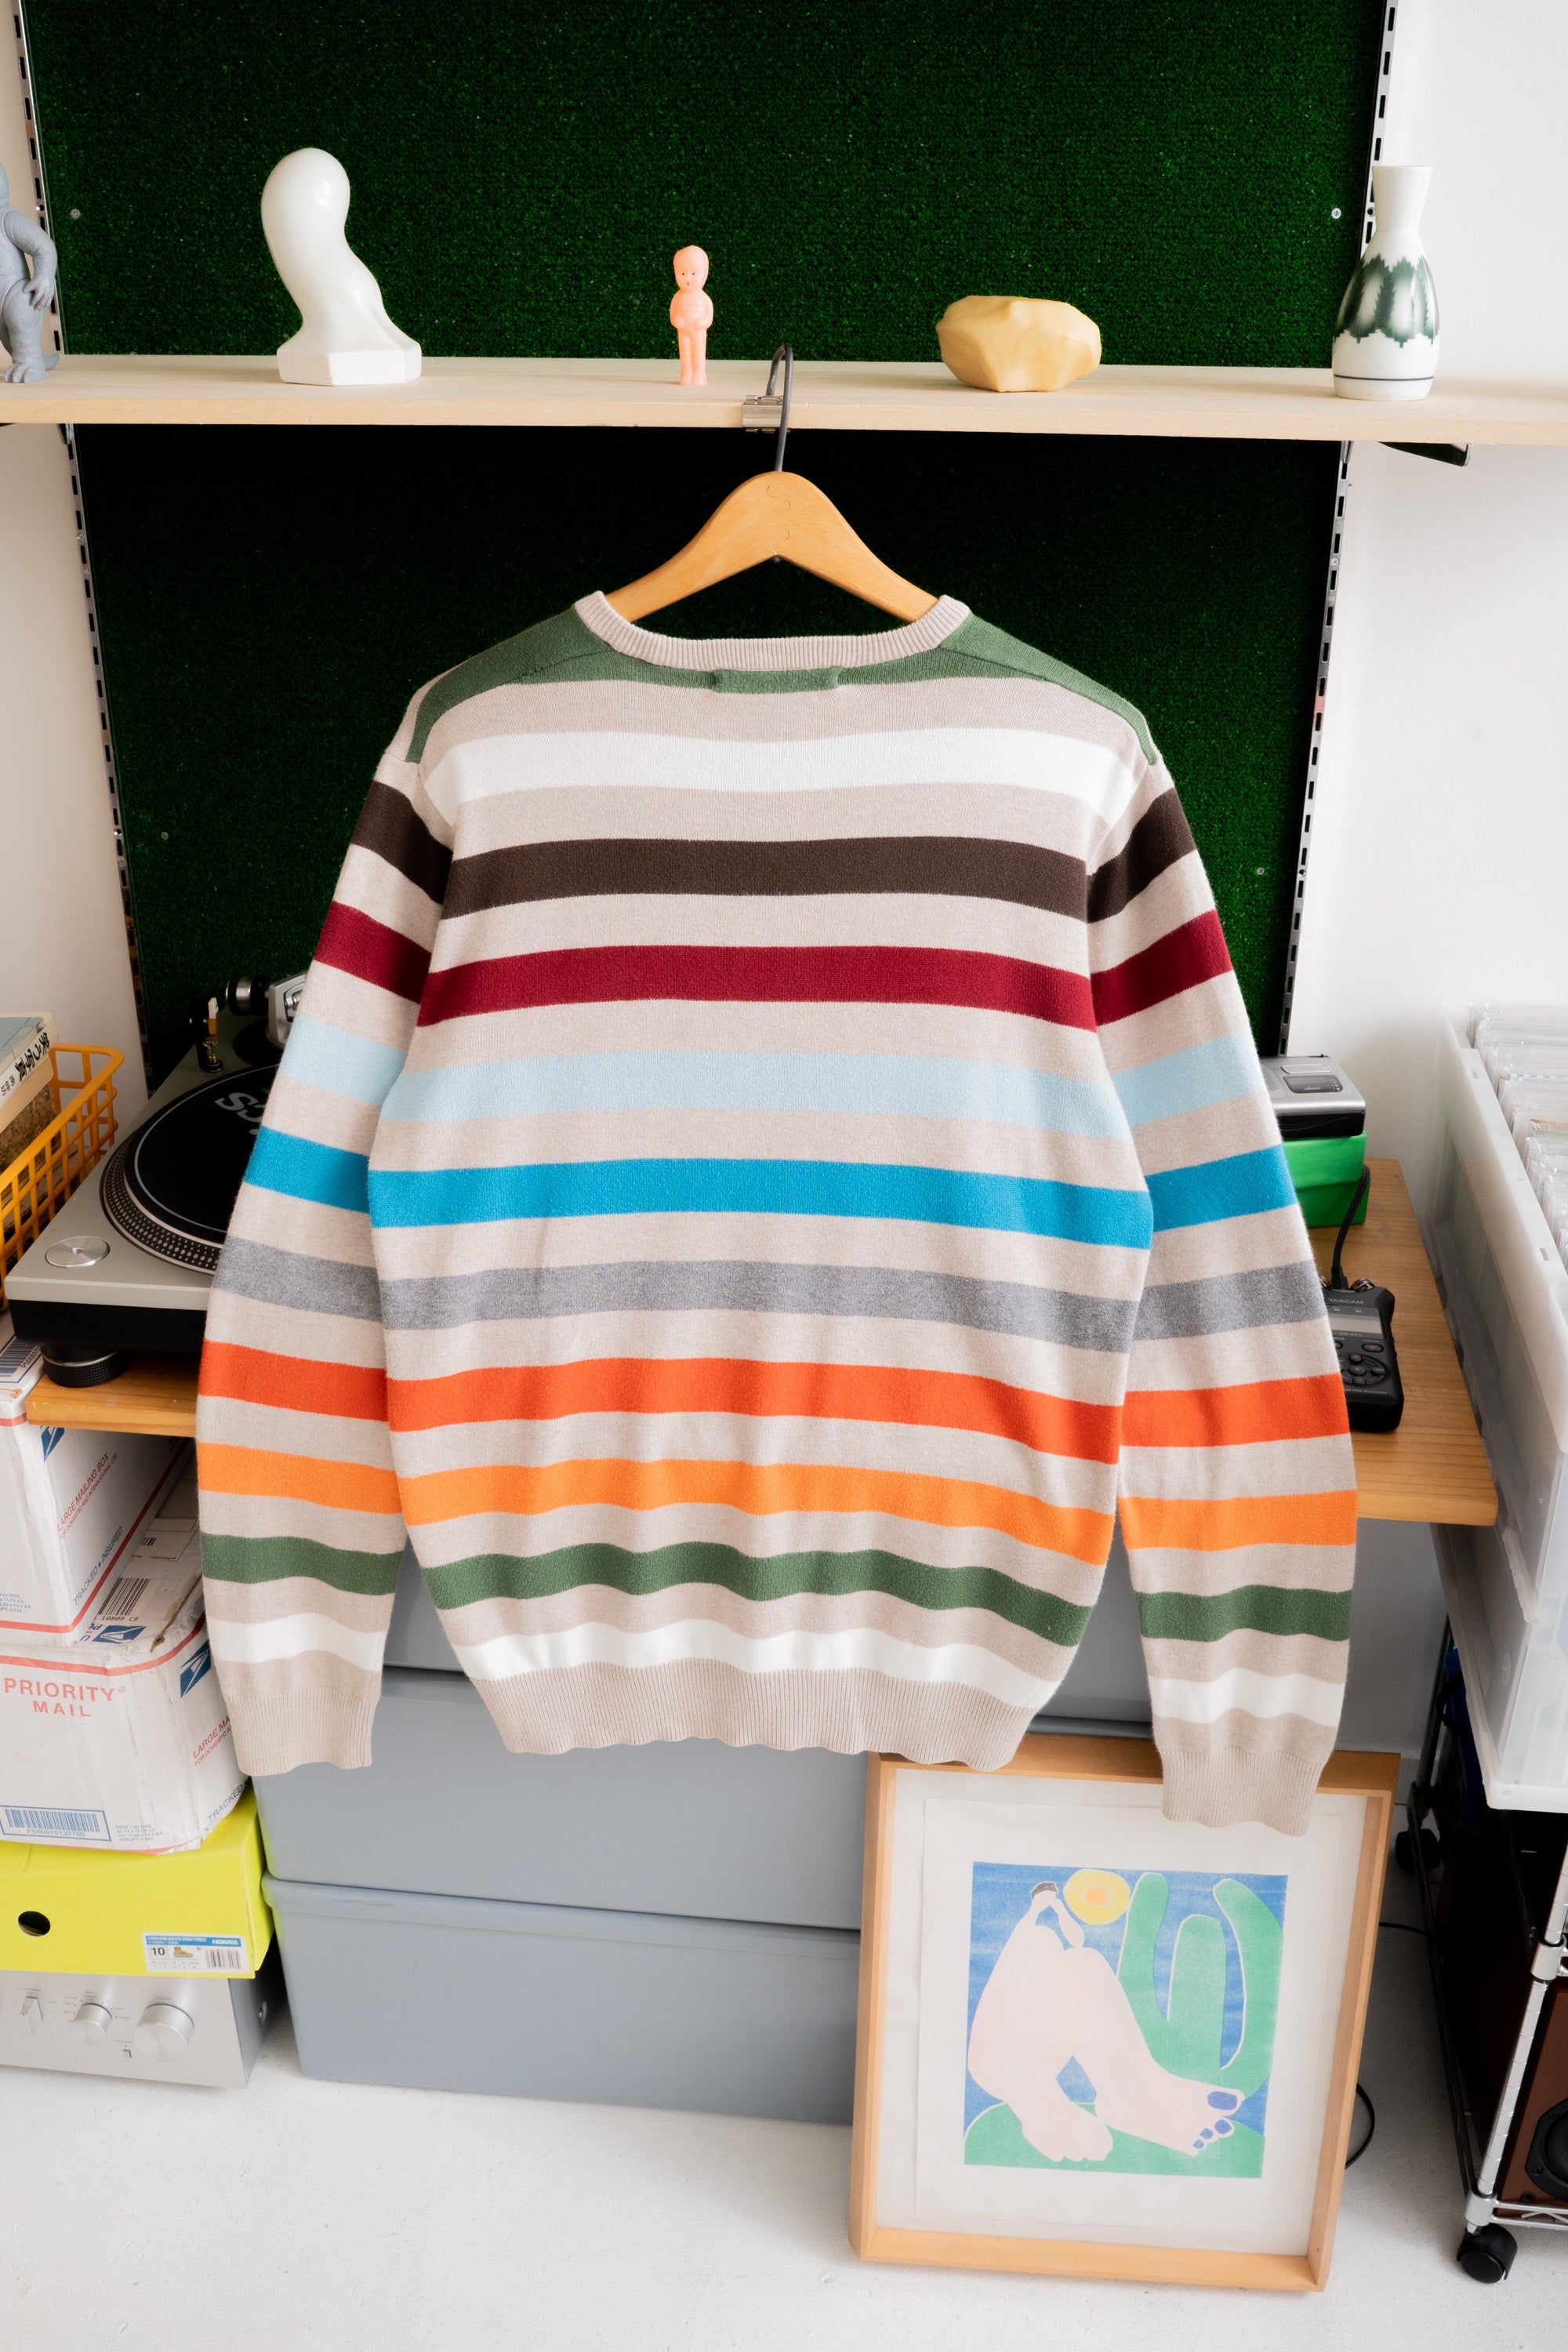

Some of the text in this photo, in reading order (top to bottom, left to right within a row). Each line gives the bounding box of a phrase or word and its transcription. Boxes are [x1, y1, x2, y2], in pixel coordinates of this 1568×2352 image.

[57, 1451, 109, 1532] LARGE MAILING BOX
[73, 1566, 98, 1606] TRACKED
[101, 1526, 123, 1563] INSURED
[4, 1677, 115, 1702] PRIORITY
[33, 1700, 91, 1717] MAIL
[193, 1727, 219, 1759] LARGE
[208, 1784, 245, 1822] TRACKED
[151, 1947, 165, 1955] 10
